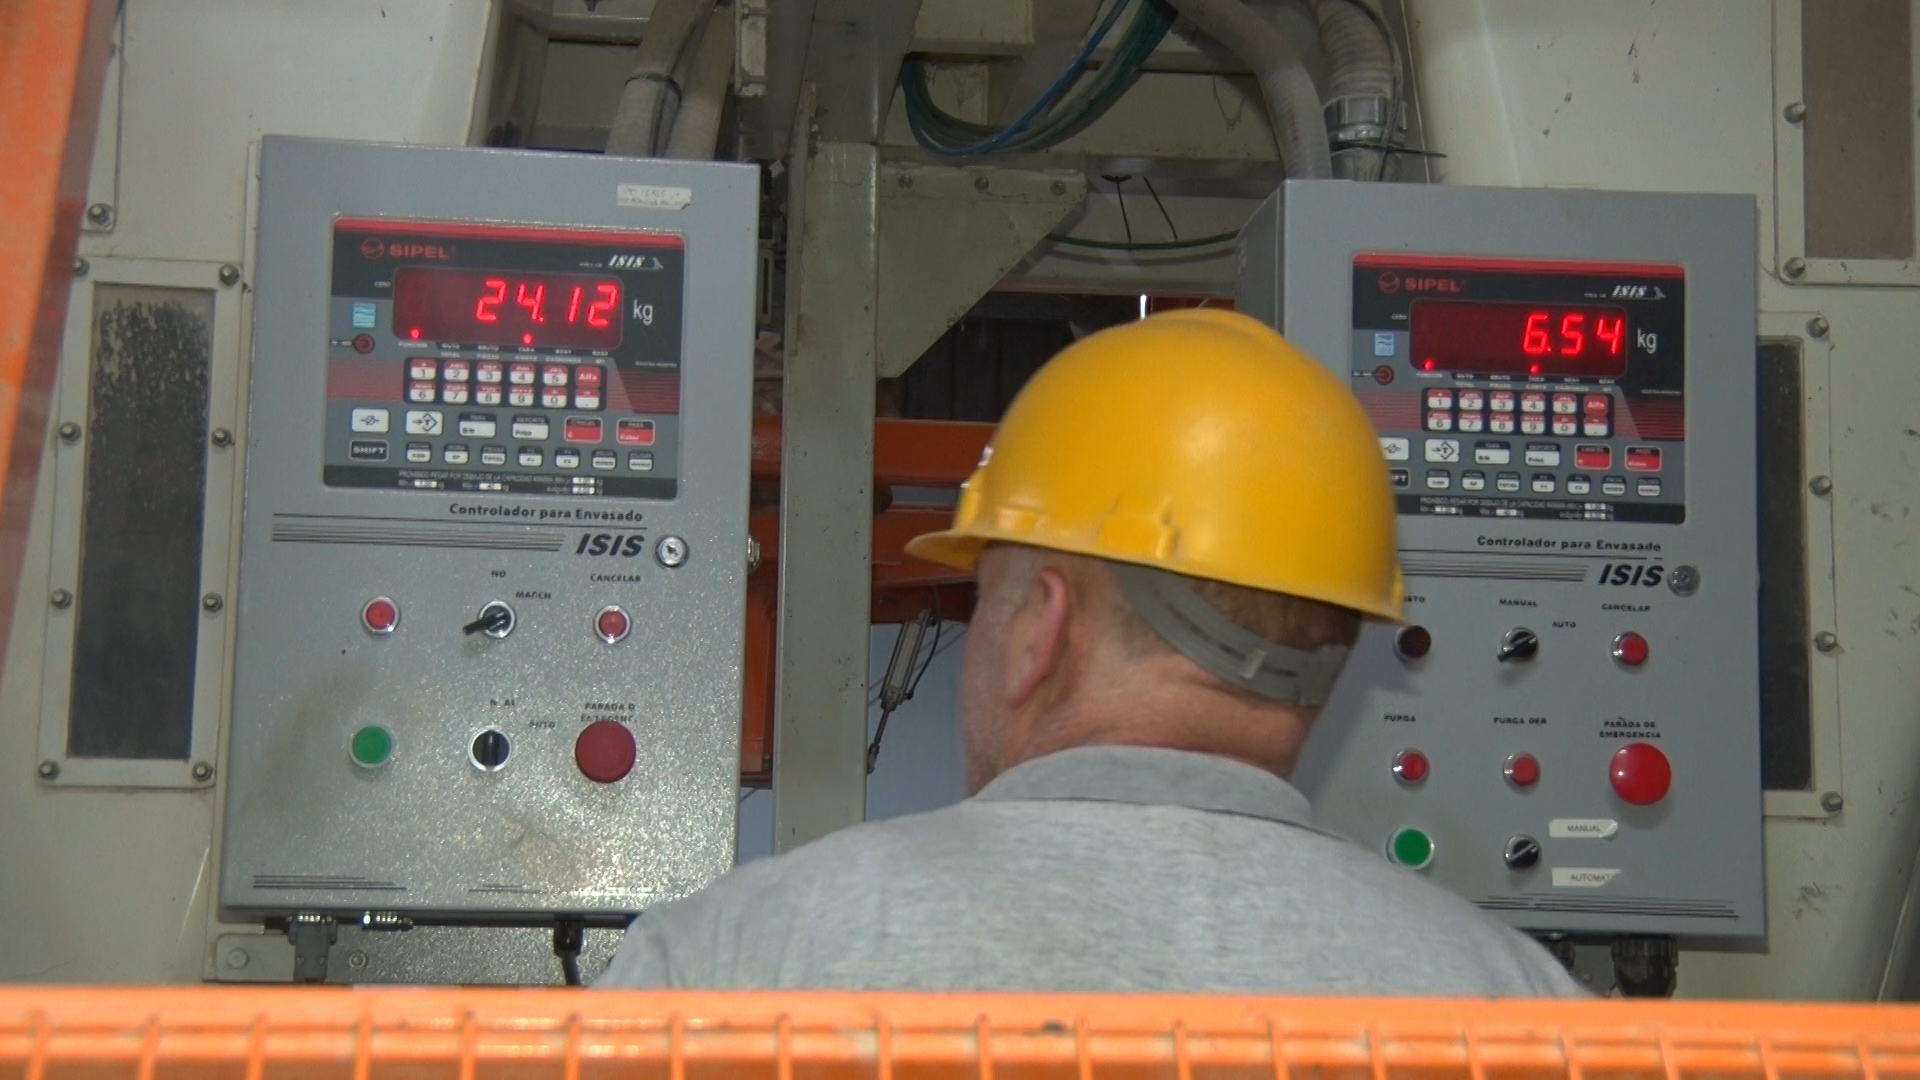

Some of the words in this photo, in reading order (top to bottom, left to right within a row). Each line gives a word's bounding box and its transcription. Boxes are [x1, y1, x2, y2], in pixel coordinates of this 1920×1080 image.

[390, 244, 449, 259] SIPEL
[608, 254, 646, 269] ISIS
[1405, 277, 1460, 293] SIPEL
[1612, 285, 1648, 299] ISIS
[476, 280, 618, 327] 24.12
[633, 299, 654, 326] kg
[1523, 313, 1622, 355] 6.54
[1637, 328, 1657, 354] kg
[353, 446, 387, 455] SHIFT
[450, 503, 536, 517] Controlador
[540, 509, 572, 520] para
[575, 509, 643, 522] Envasado
[575, 533, 645, 557] ISIS
[1477, 536, 1556, 549] Controlador
[1561, 540, 1591, 551] para
[1596, 539, 1661, 552] Envasado
[1598, 564, 1664, 587] ISIS
[1499, 599, 1538, 608] MANUAL
[1552, 621, 1576, 629] AUTO
[1384, 714, 1416, 723] PURGA
[1493, 717, 1525, 725] PURGA
[1604, 720, 1641, 728] PARADA
[1600, 731, 1661, 739] EMERGENCIA
